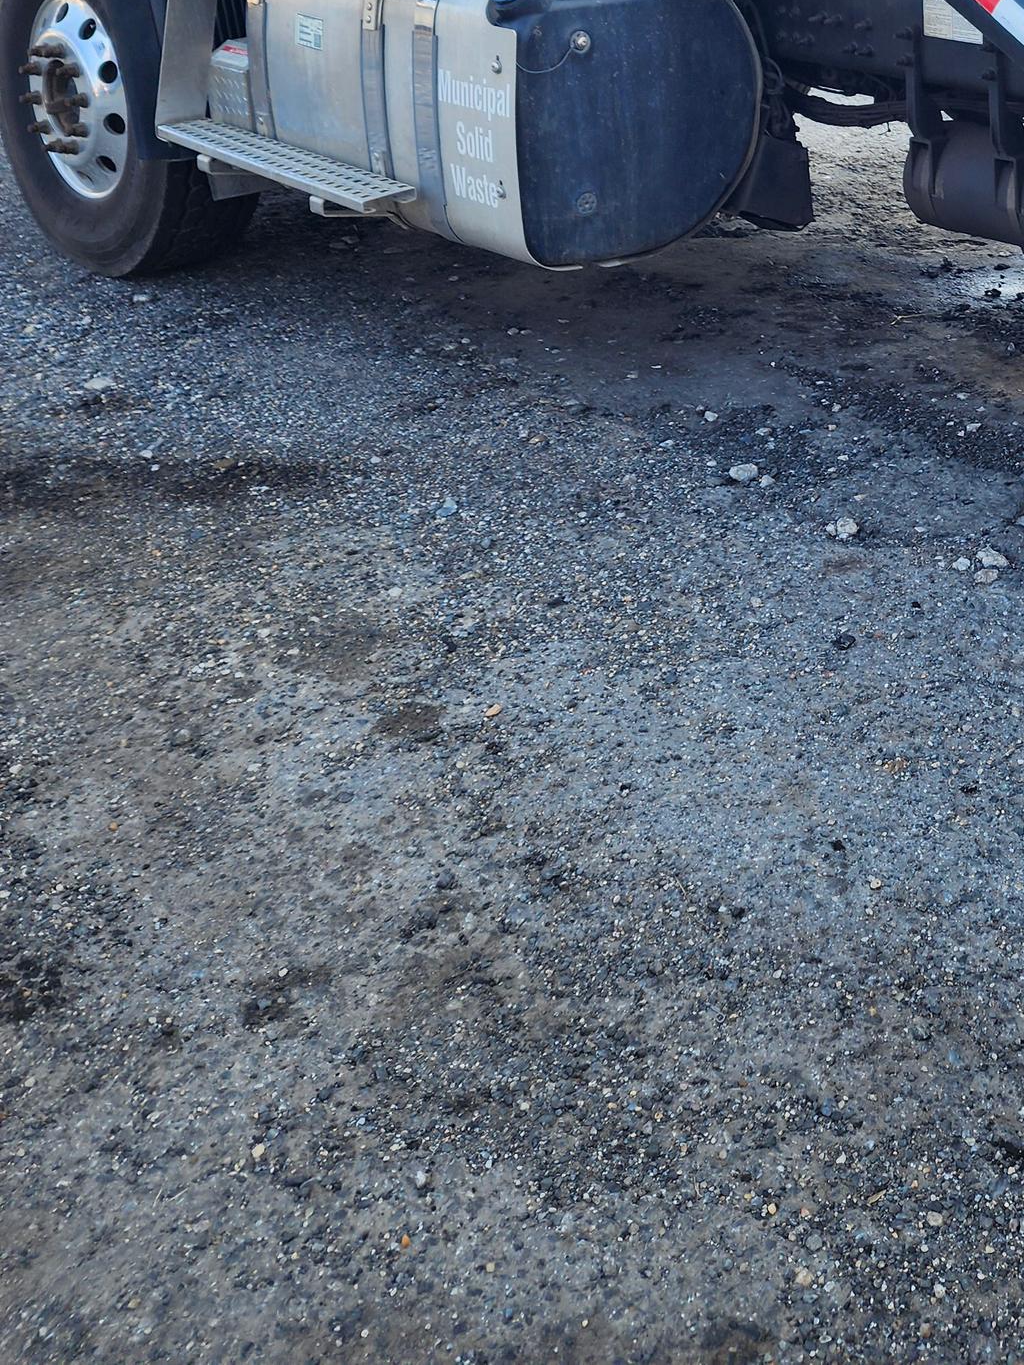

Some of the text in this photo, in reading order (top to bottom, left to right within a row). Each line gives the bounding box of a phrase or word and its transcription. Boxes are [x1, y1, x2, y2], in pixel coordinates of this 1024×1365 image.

[437, 68, 510, 121] Municipal
[456, 121, 493, 163] Solid
[450, 163, 499, 208] Waste
